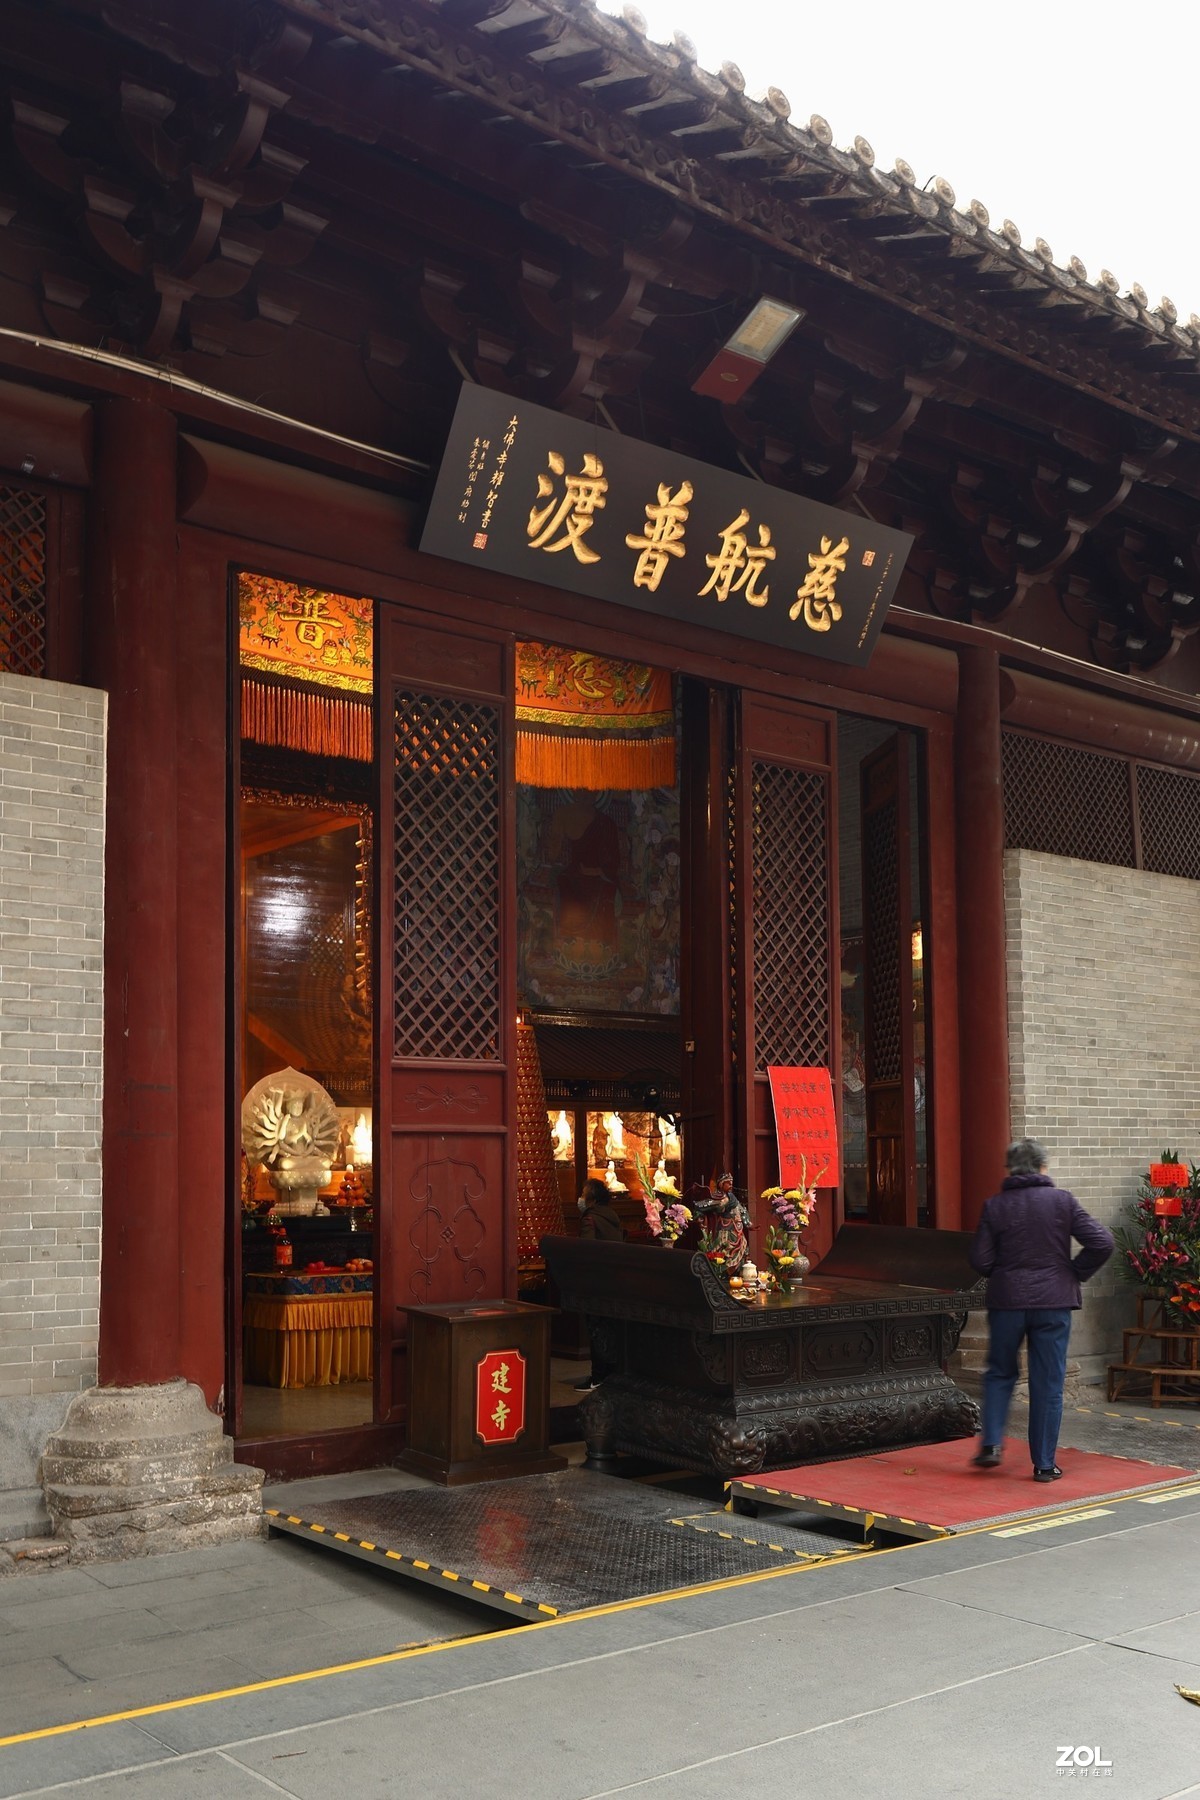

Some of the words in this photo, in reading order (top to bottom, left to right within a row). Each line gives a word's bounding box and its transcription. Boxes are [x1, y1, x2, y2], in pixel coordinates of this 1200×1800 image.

[527, 450, 850, 632] 慈航普渡
[490, 1362, 513, 1431] 建寺
